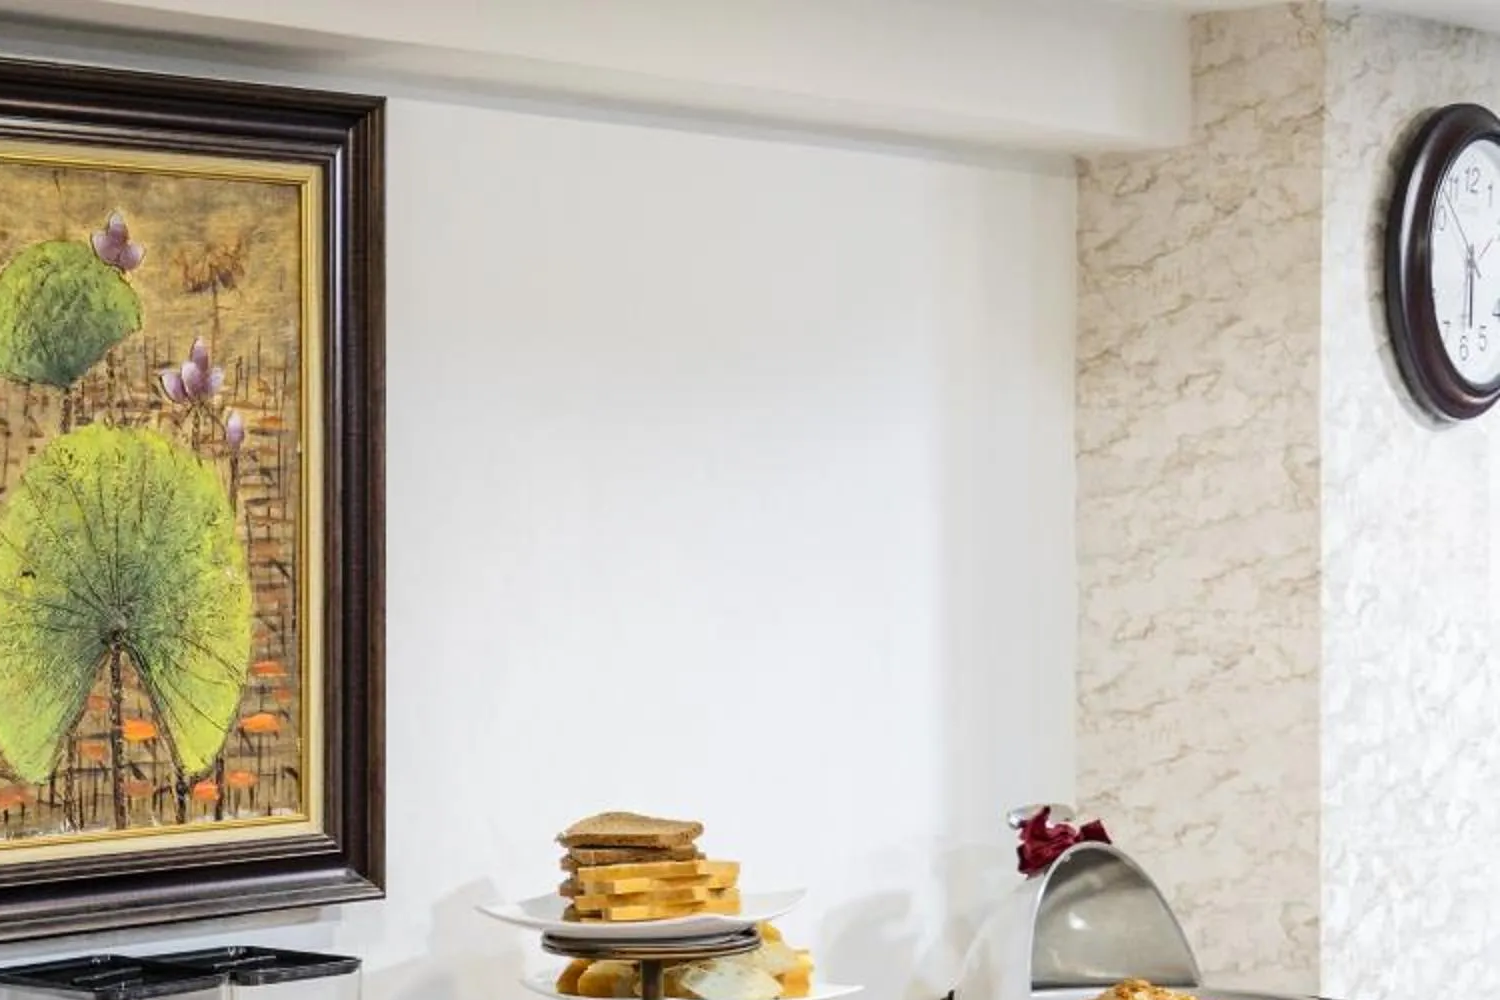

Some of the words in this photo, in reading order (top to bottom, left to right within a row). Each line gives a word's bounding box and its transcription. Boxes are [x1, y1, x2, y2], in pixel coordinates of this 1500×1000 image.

[1465, 166, 1481, 194] 12
[1459, 335, 1469, 361] 6
[1478, 324, 1488, 352] 5
